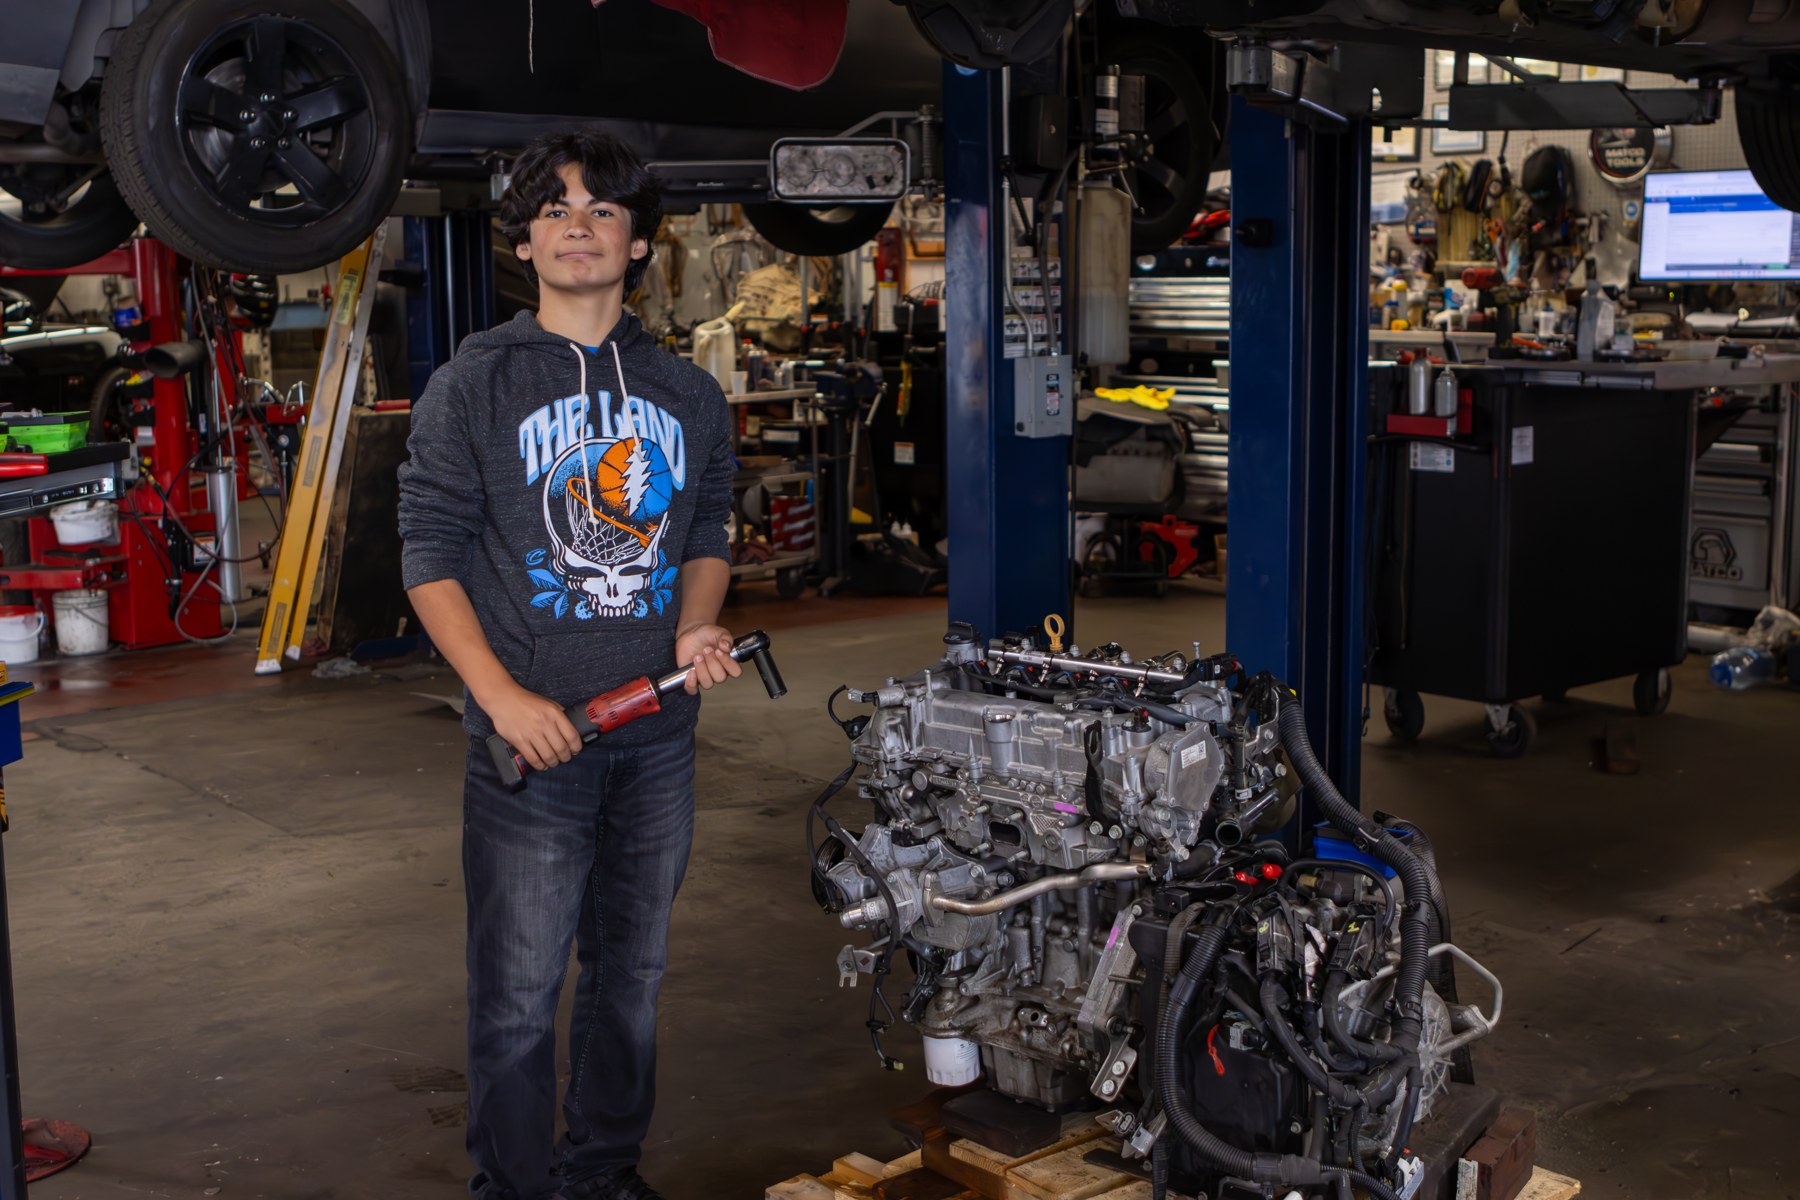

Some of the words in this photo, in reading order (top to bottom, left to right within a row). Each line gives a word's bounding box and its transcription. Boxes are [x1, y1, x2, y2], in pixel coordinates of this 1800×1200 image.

[1605, 147, 1646, 157] MATCO
[1606, 157, 1646, 168] TOOLS
[518, 393, 595, 486] THE
[598, 390, 686, 491] LAND
[1690, 562, 1742, 580] ATCO
